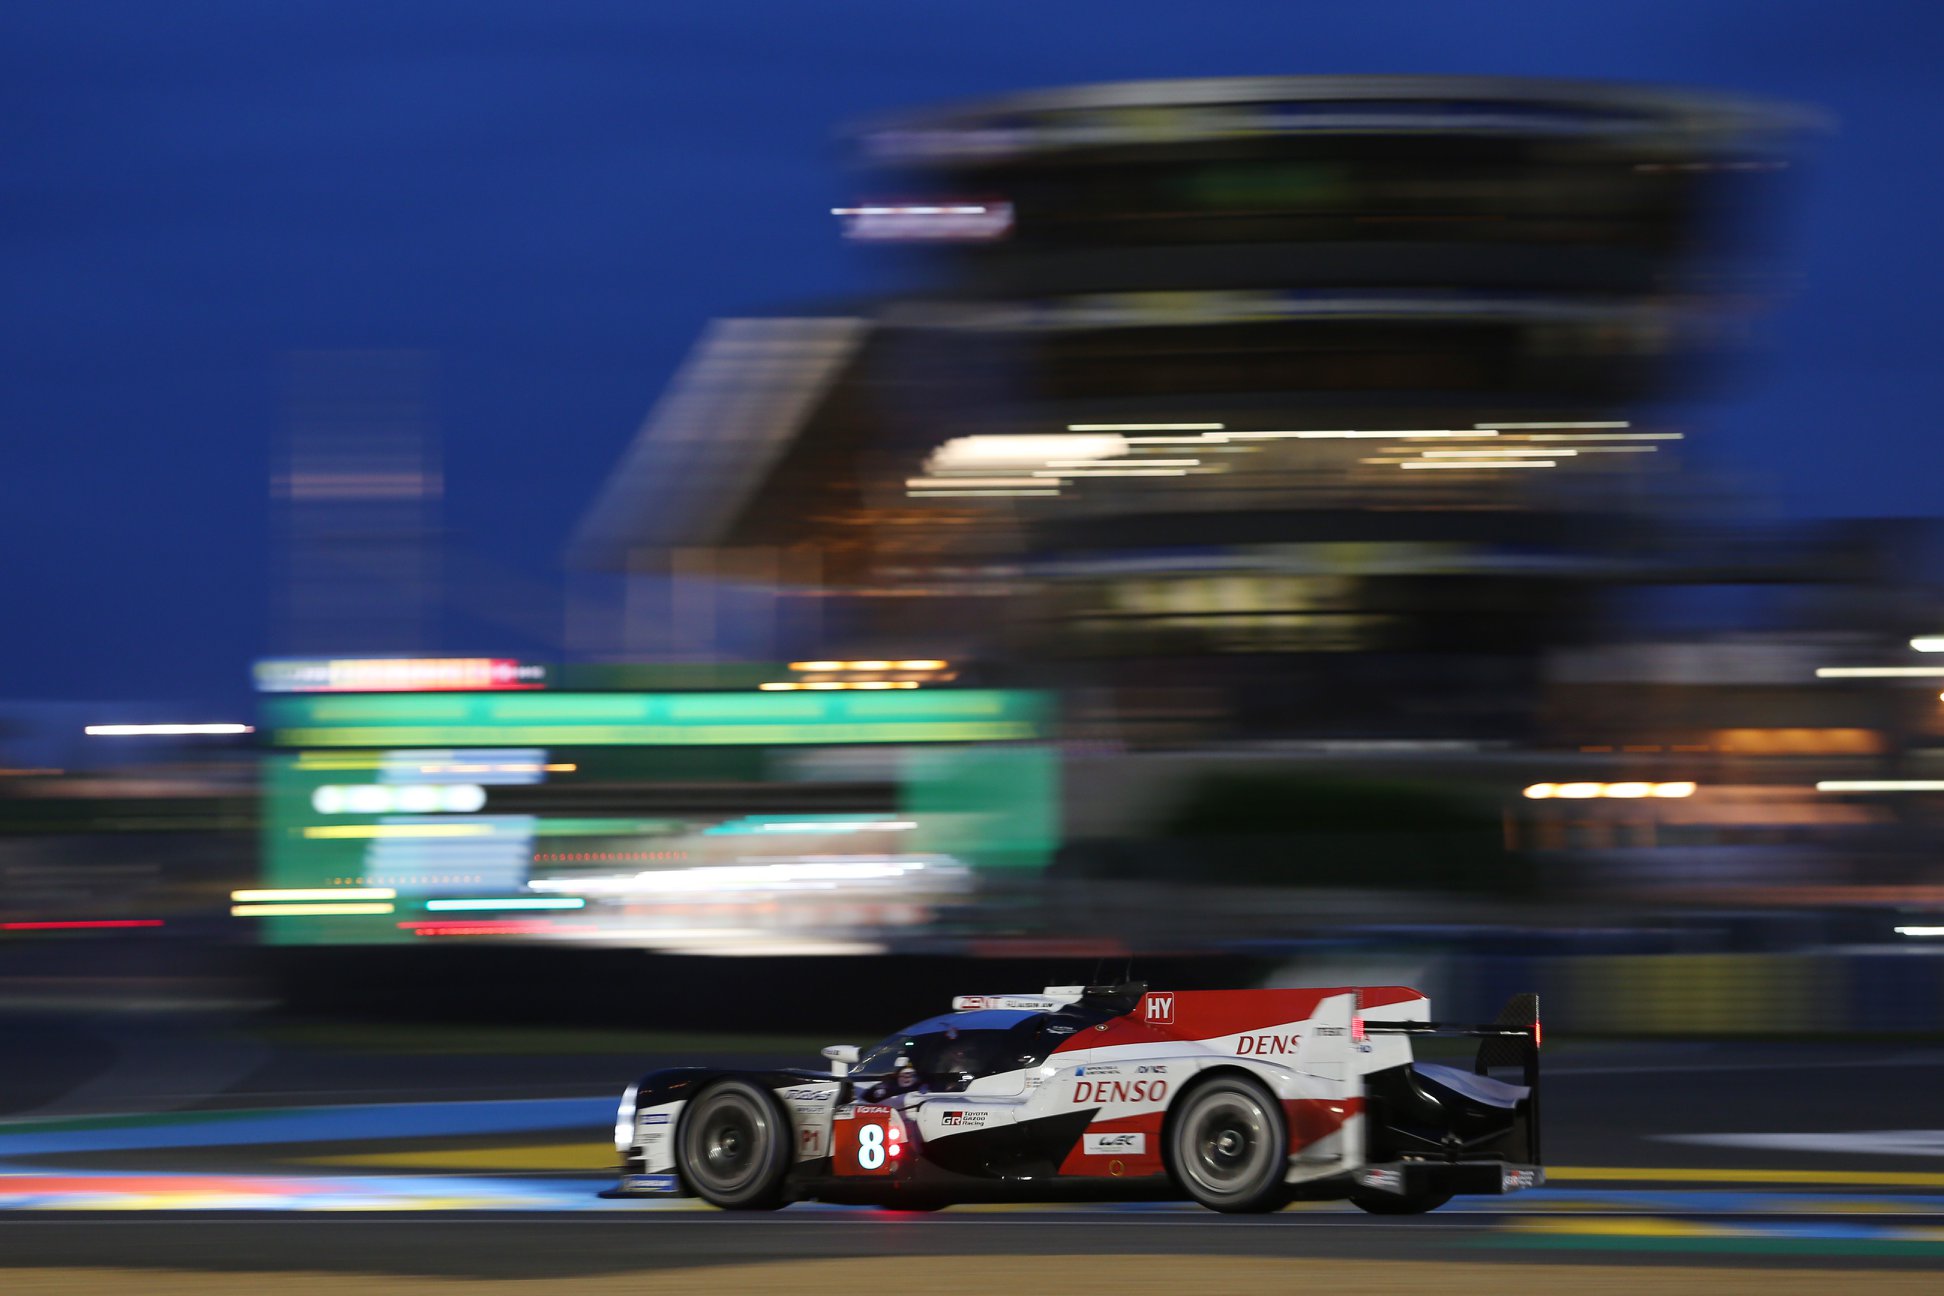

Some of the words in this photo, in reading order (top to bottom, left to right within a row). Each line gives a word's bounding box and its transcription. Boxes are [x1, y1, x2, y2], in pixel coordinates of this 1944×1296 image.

[1147, 997, 1172, 1019] HY
[1236, 1035, 1302, 1055] DENS
[1073, 1080, 1168, 1103] DENSO
[856, 1105, 889, 1114] TOTAL
[942, 1116, 961, 1126] GR
[858, 1123, 885, 1170] 8
